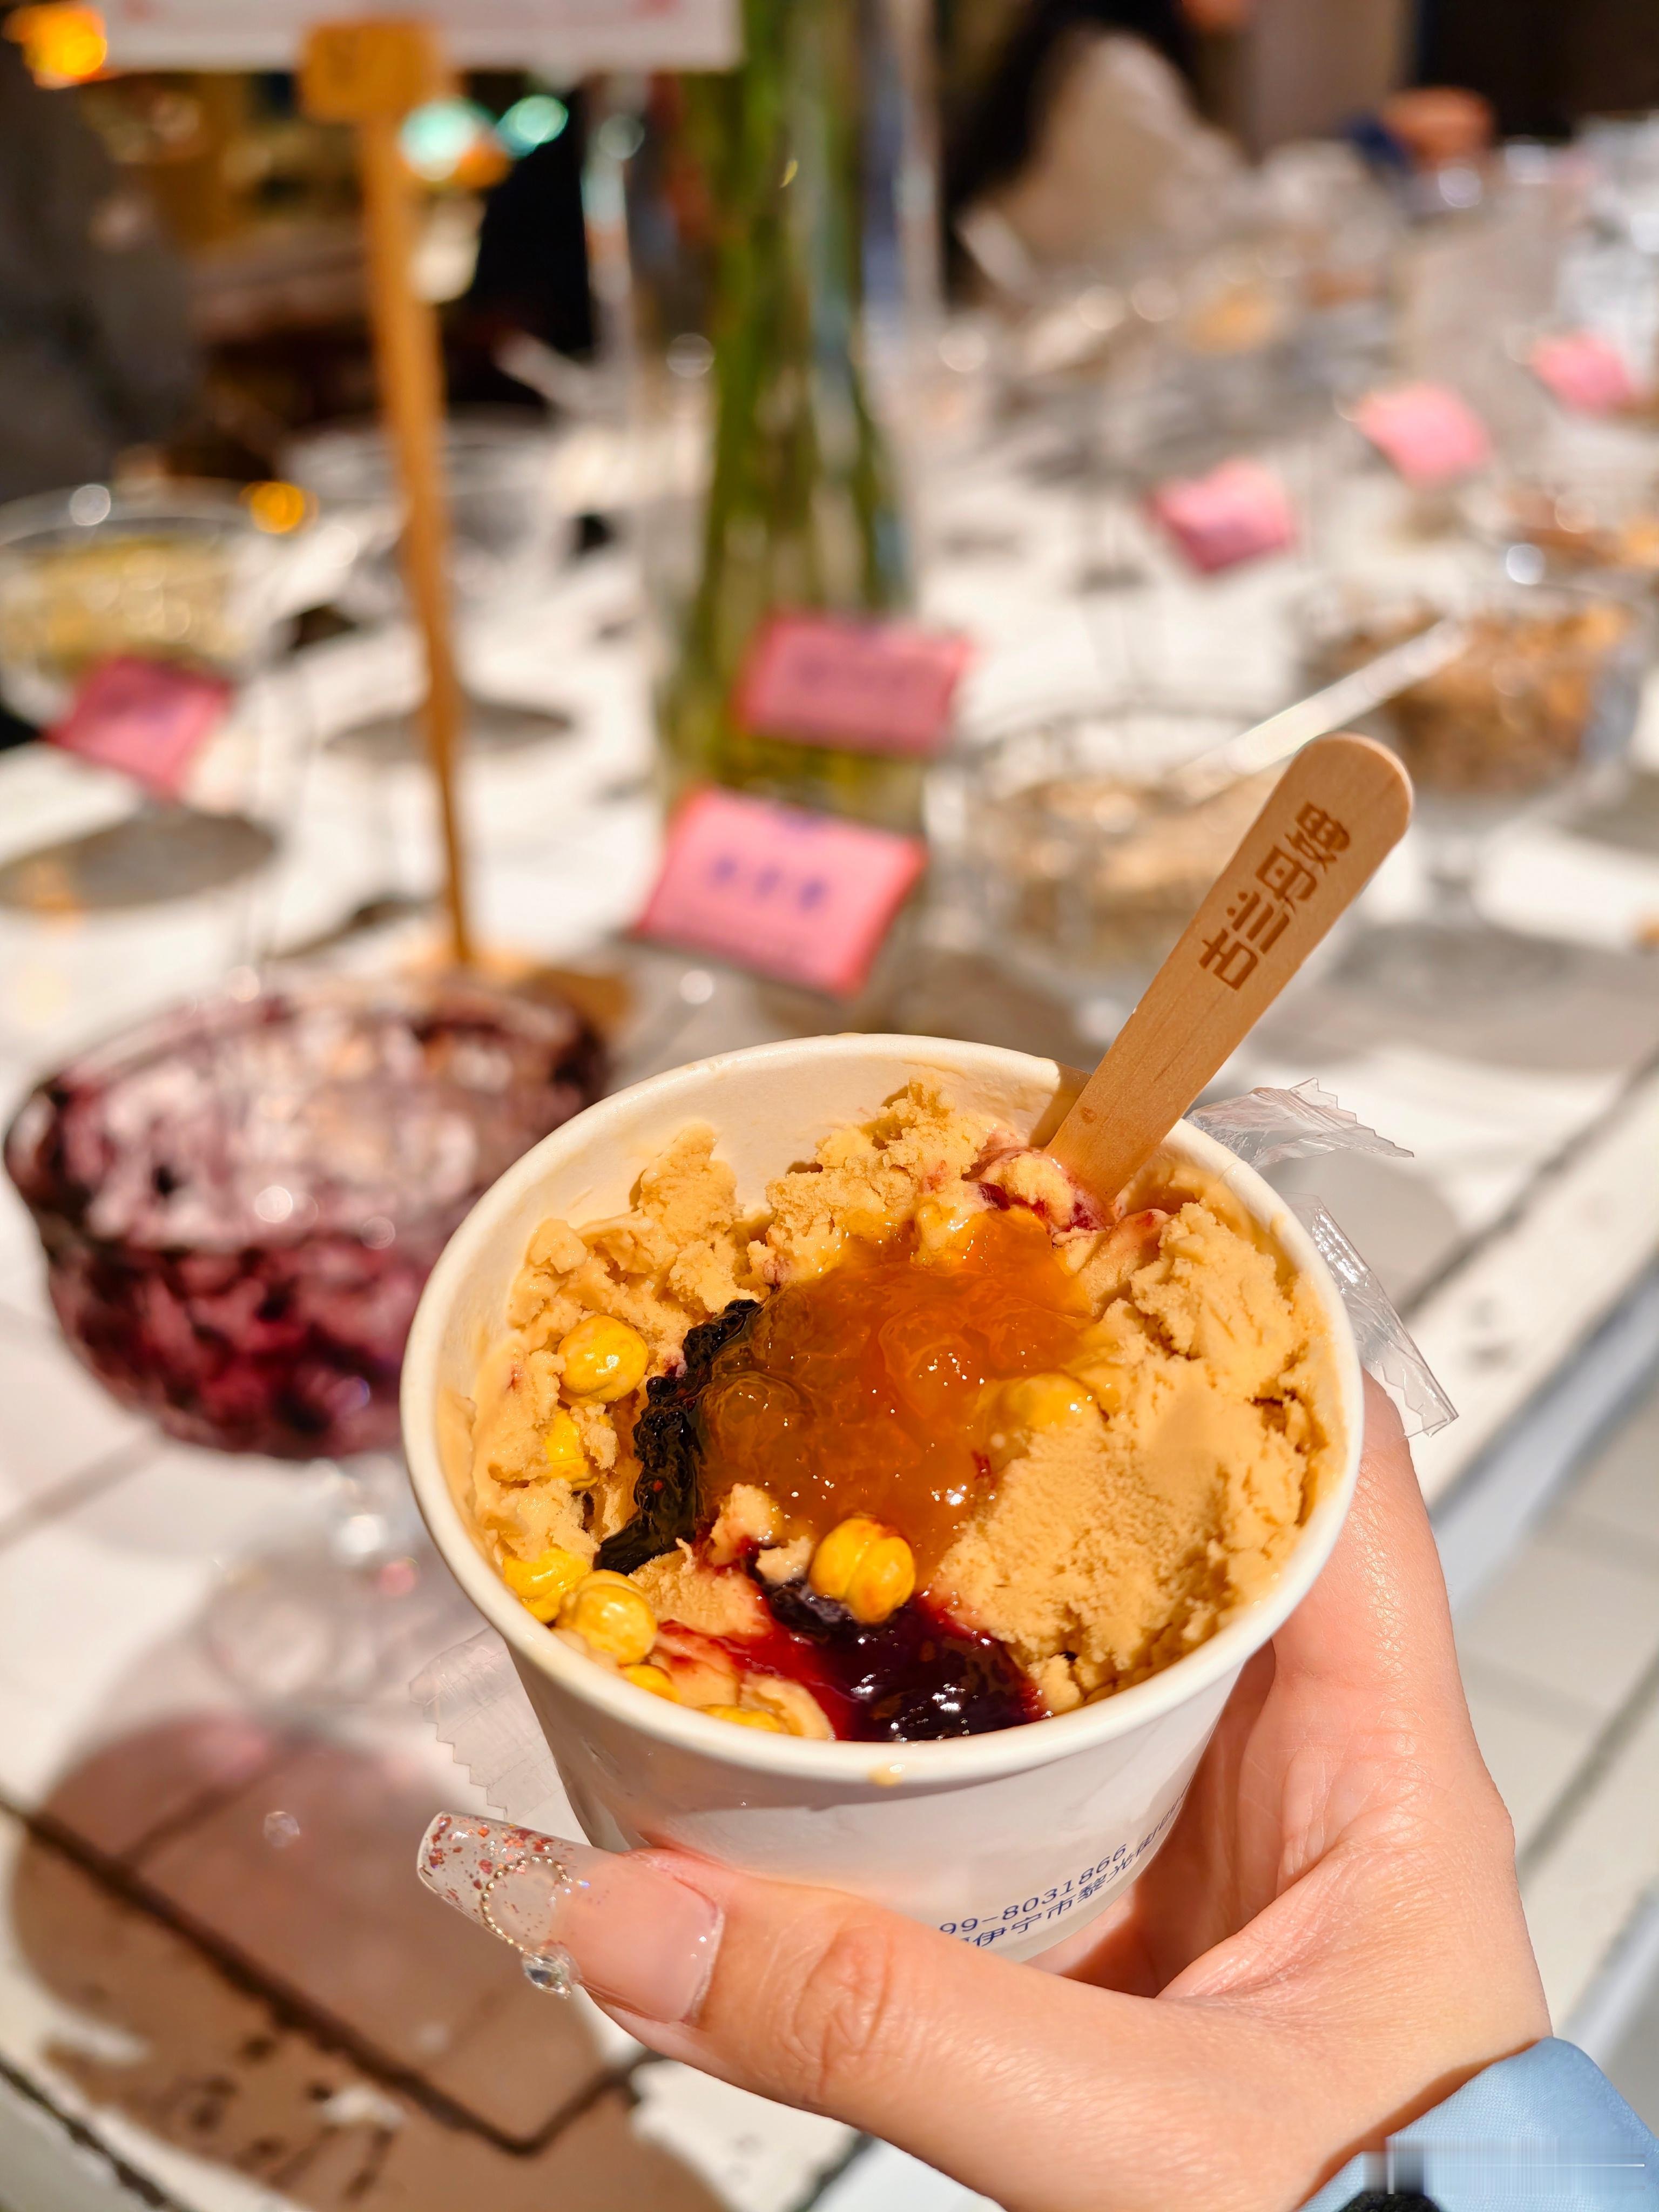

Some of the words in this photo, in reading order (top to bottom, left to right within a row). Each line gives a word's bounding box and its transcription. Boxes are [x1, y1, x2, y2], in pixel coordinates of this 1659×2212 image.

[1199, 801, 1350, 990] 古兰丹姆
[939, 1843, 1127, 1934] 99-8031866
